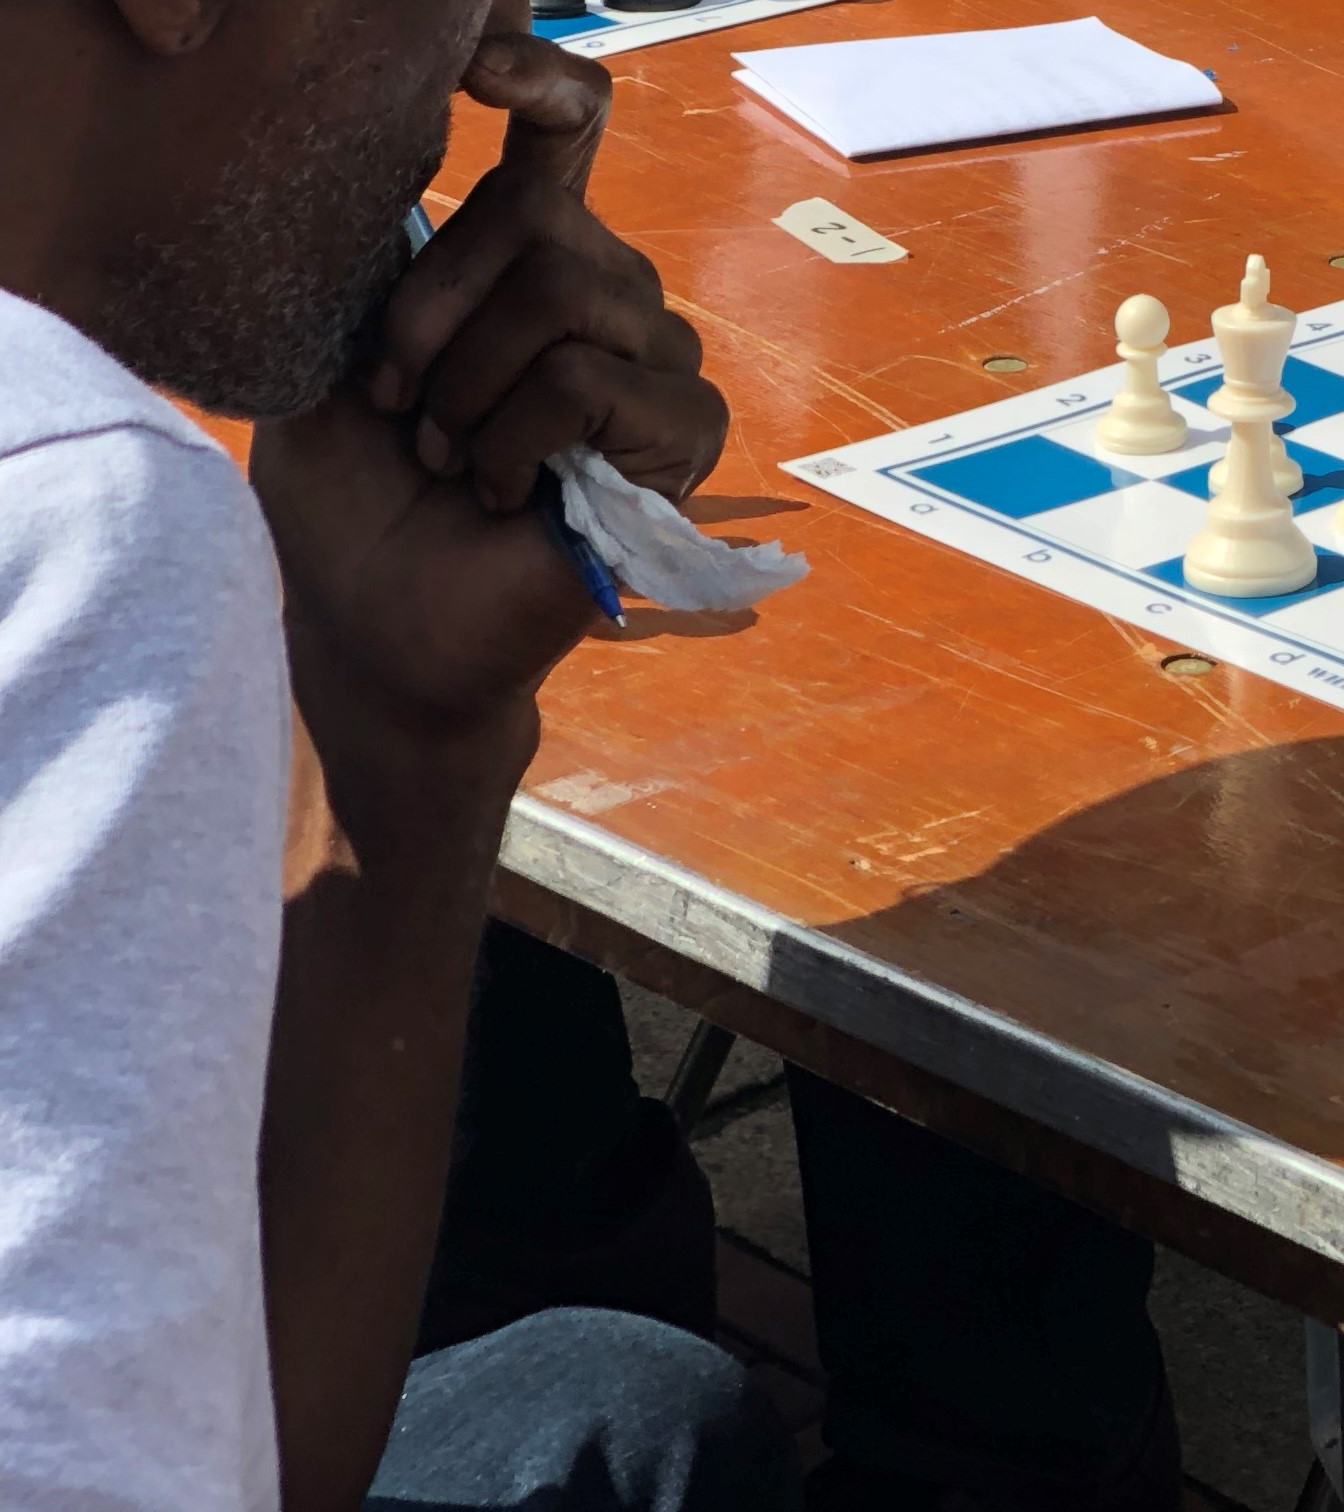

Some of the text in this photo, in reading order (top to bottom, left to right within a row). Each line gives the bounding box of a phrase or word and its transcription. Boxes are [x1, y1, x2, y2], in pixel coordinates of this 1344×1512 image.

[1184, 352, 1212, 365] 3
[1055, 393, 1088, 409] 2
[927, 432, 954, 445] 1
[908, 502, 940, 516] a
[1023, 548, 1052, 564] b
[1144, 603, 1172, 616] c
[1269, 651, 1306, 667] d
